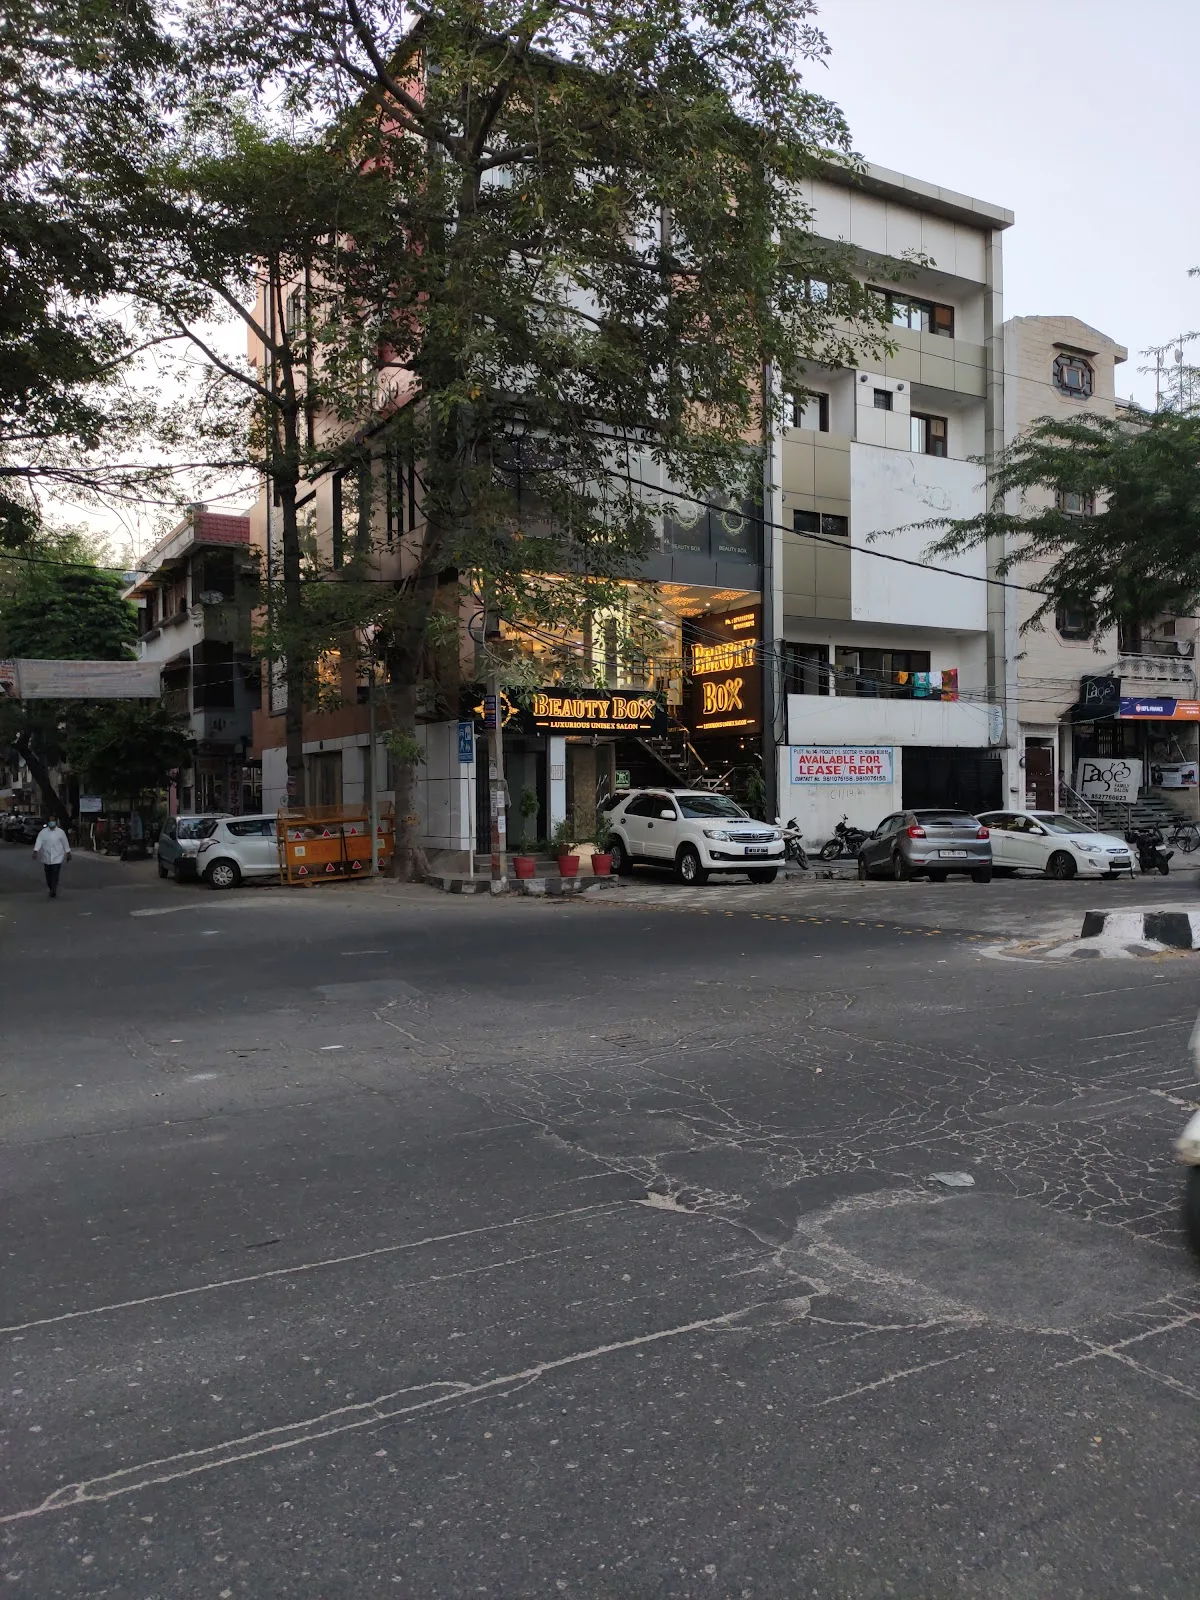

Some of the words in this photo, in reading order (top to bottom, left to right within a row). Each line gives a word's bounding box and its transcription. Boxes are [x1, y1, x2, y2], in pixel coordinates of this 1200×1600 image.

[691, 638, 756, 676] BEAUTY
[533, 693, 610, 719] BEAUTY
[612, 695, 656, 720] BOX
[703, 677, 743, 715] BOX
[591, 722, 615, 730] UNISEX
[799, 755, 855, 764] AVAILABLE
[860, 755, 880, 764] FOR
